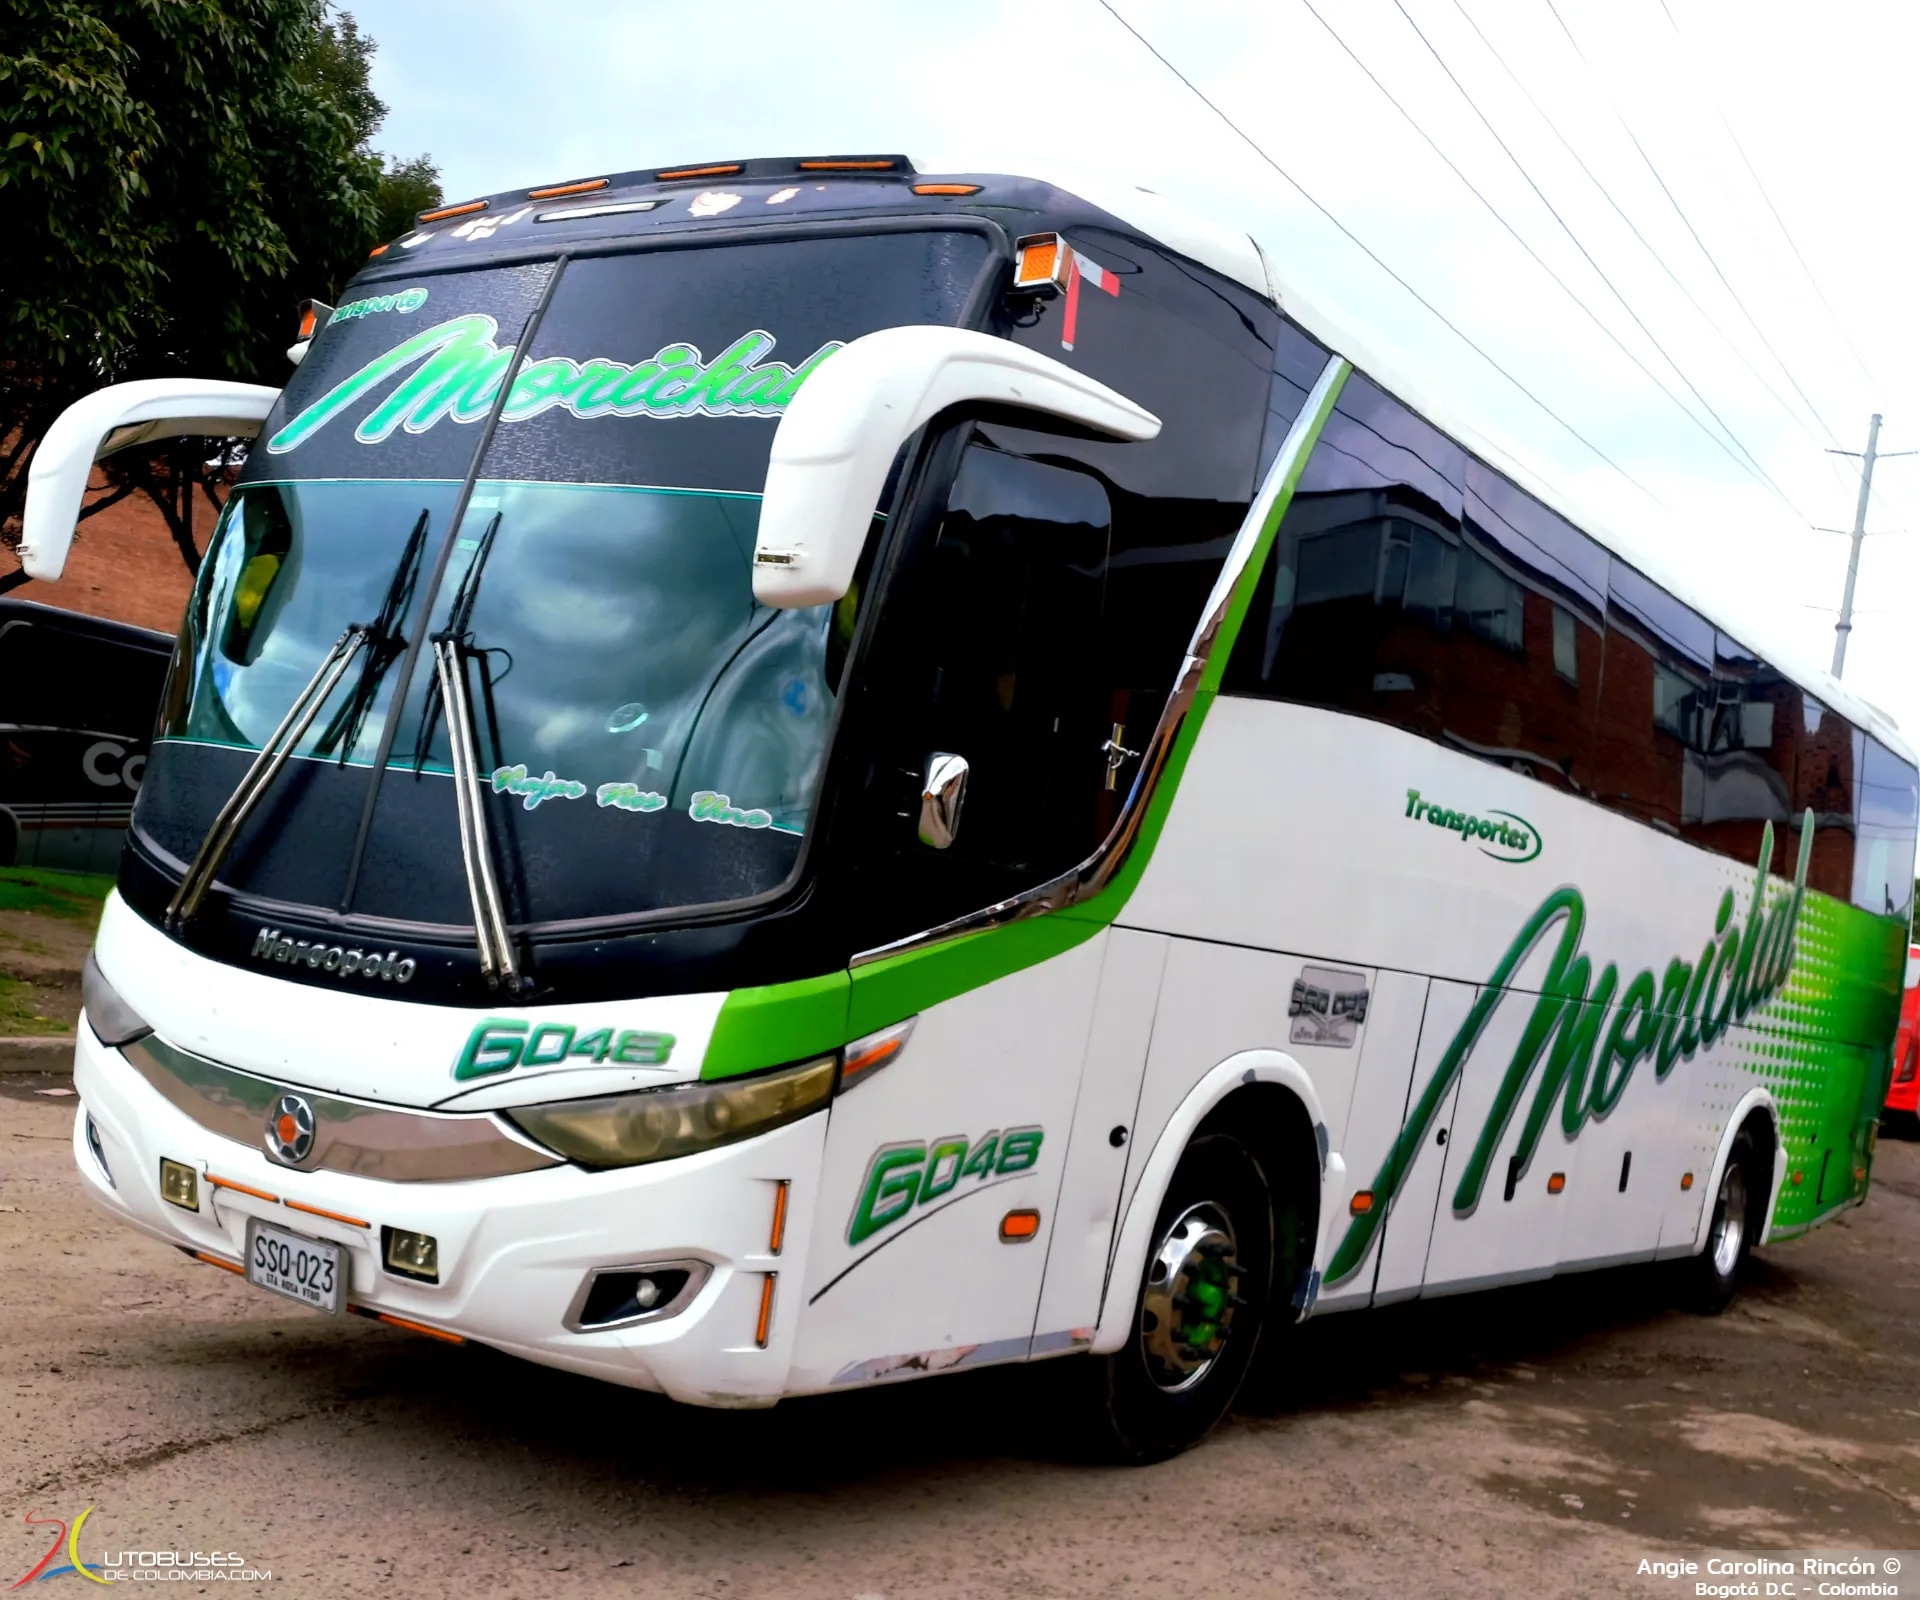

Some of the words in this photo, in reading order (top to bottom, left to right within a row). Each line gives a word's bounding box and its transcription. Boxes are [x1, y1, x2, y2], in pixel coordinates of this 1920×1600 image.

[1405, 788, 1530, 851] Transportes
[251, 927, 416, 983] Marcopolo
[451, 1017, 677, 1082] 6048
[1322, 807, 1814, 1286] Morichal
[845, 1125, 1044, 1247] 6048
